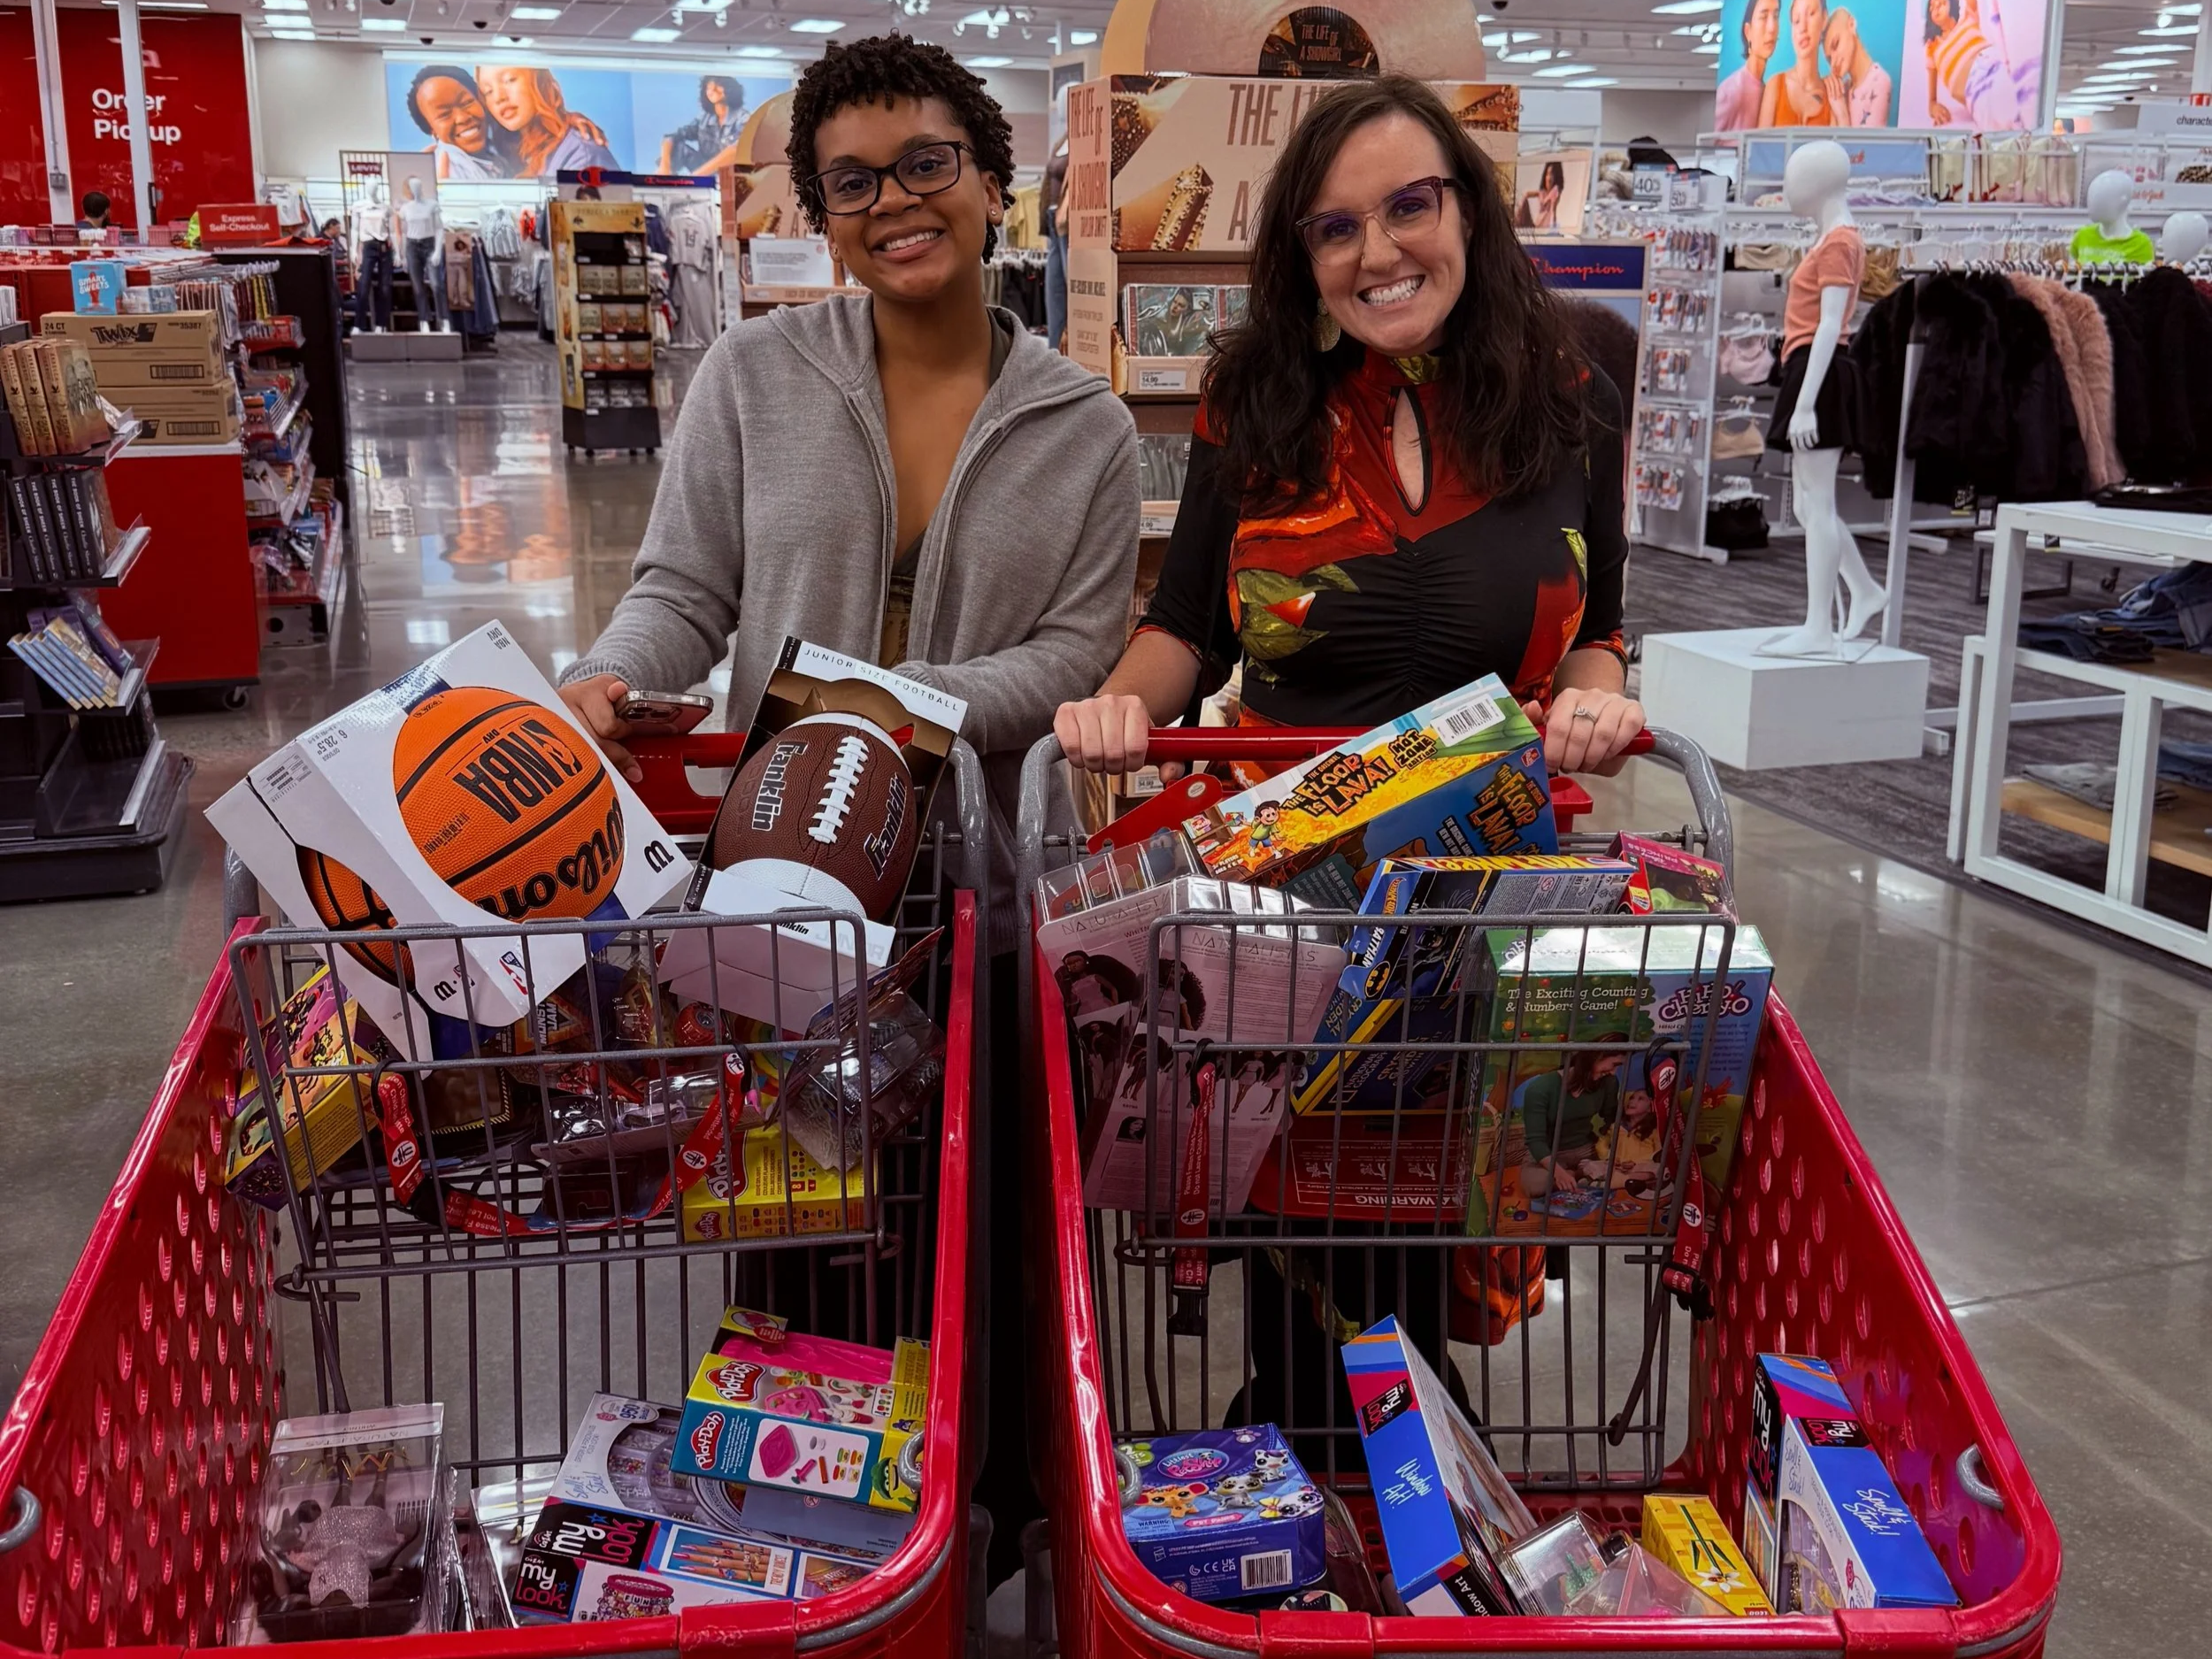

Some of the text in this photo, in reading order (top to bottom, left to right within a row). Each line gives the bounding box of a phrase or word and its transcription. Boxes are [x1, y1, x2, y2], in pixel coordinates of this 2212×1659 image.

[92, 88, 166, 111] Orer
[1227, 84, 1282, 146] THE
[94, 119, 181, 146] Picup
[210, 223, 270, 233] Self-Checkout
[493, 637, 511, 650] NBA
[804, 648, 853, 668] JUNIOR
[859, 665, 889, 682] SIZE
[894, 680, 959, 712] FOOTBALL
[338, 729, 348, 740] 6
[482, 728, 500, 744] DRV
[1391, 729, 1420, 756] HOT
[1317, 754, 1341, 774] ORIGINAL
[1395, 737, 1436, 766] ZONE
[1408, 747, 1436, 770] EDITION
[452, 731, 565, 825] NBA
[751, 740, 809, 833] Franklin
[1284, 754, 1363, 810] THE FLOOR
[1321, 757, 1395, 814] LAVA!
[1497, 765, 1537, 826] THE FLOOR
[863, 772, 908, 881] Franklin
[1469, 798, 1520, 855] LAVA!
[1626, 842, 1678, 863] PRINCESS
[1384, 901, 1397, 916] HOT
[547, 1002, 557, 1031] JAM
[1506, 1002, 1516, 1012] &
[1579, 1000, 1618, 1011] Game!
[1355, 1194, 1432, 1205] WARNING
[726, 1362, 759, 1402] Play-Doh
[620, 1404, 640, 1420] 950
[1381, 1385, 1401, 1414] my
[1754, 1382, 1771, 1452] my
[1828, 1421, 1854, 1438] my
[698, 1413, 723, 1468] Play-Doh
[1395, 1458, 1433, 1497] Window
[1382, 1483, 1412, 1509] Art!
[1856, 1488, 1906, 1518] Spell
[1842, 1502, 1901, 1536] Stack!
[551, 1521, 607, 1555] my
[581, 1518, 645, 1564] look
[520, 1563, 557, 1590] my
[1455, 1576, 1471, 1594] Art
[516, 1578, 566, 1610] look
[624, 1594, 650, 1606] FUN
